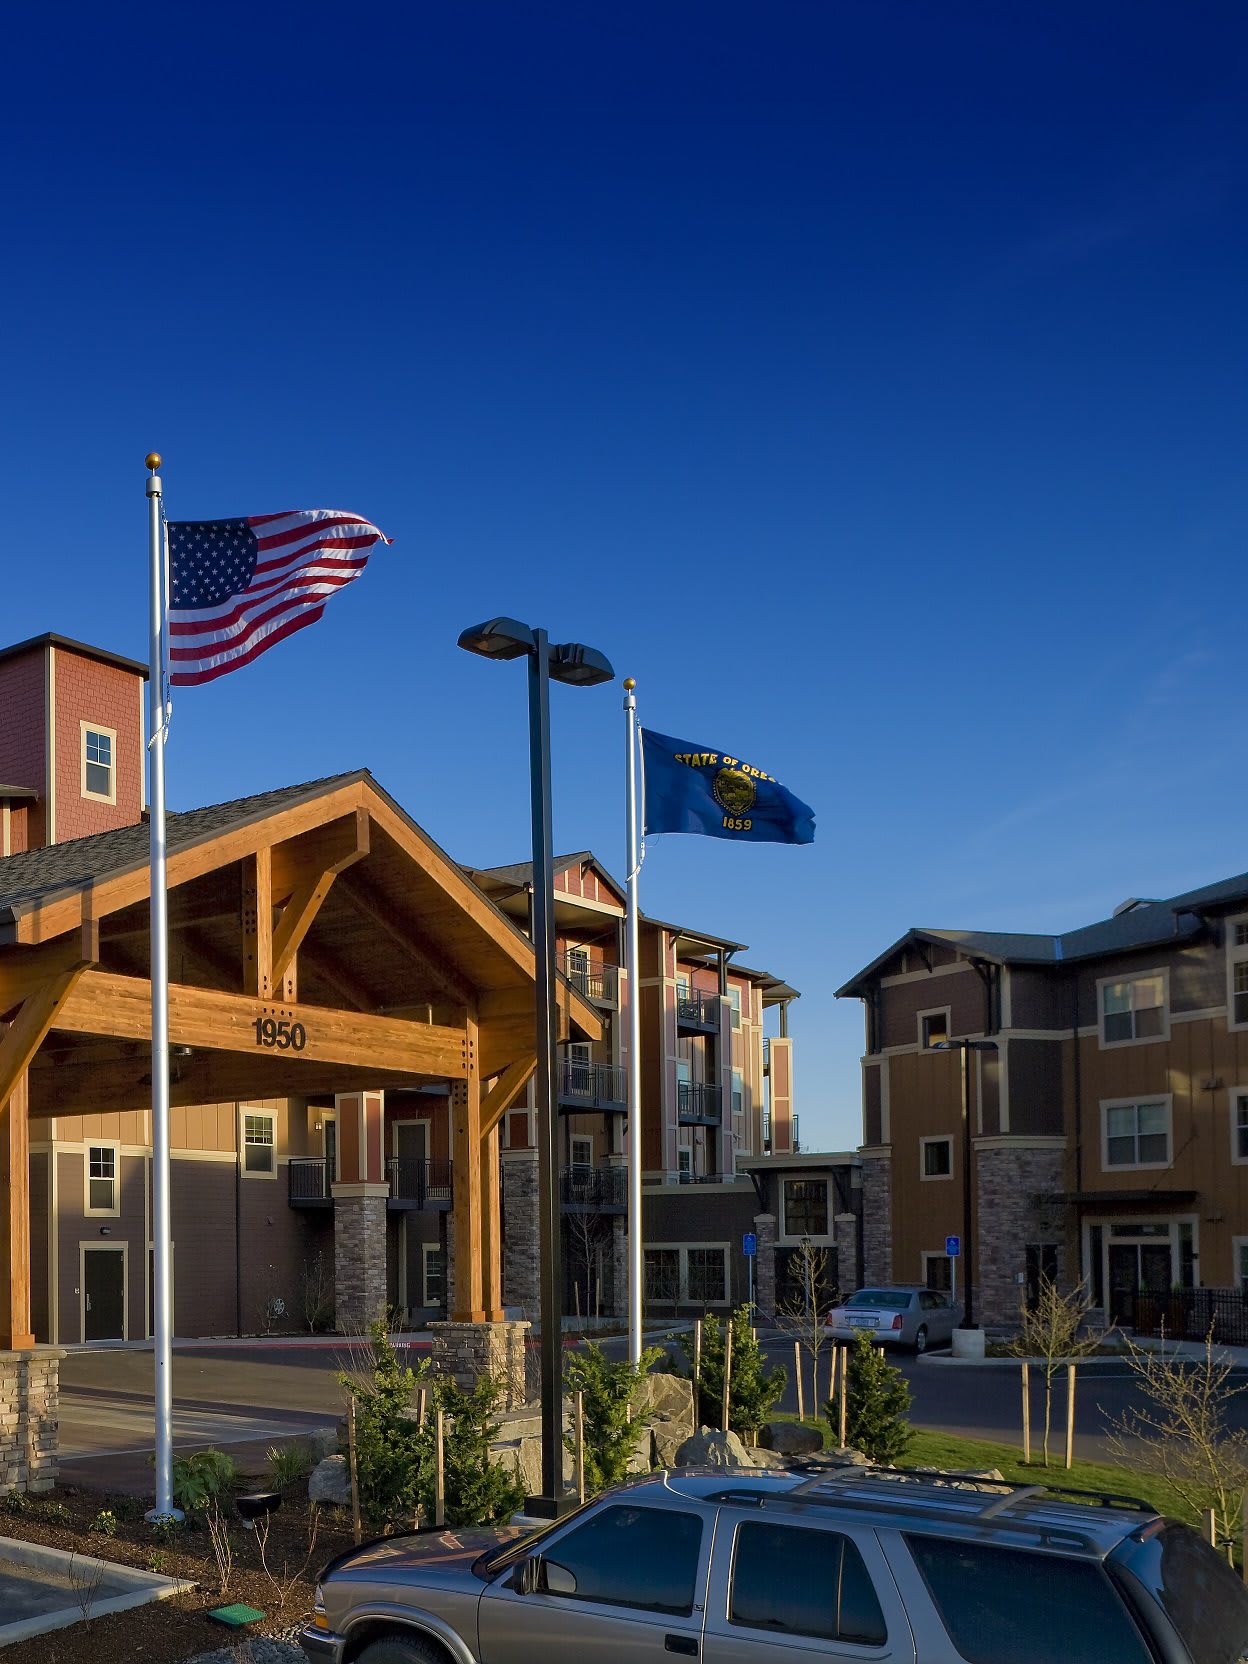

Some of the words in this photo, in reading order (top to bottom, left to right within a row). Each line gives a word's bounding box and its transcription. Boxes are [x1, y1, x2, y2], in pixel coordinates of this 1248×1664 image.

[674, 753, 718, 767] STATE
[723, 756, 739, 766] OF
[742, 764, 779, 783] ORE
[723, 816, 752, 830] 1859
[252, 1017, 306, 1051] 1950
